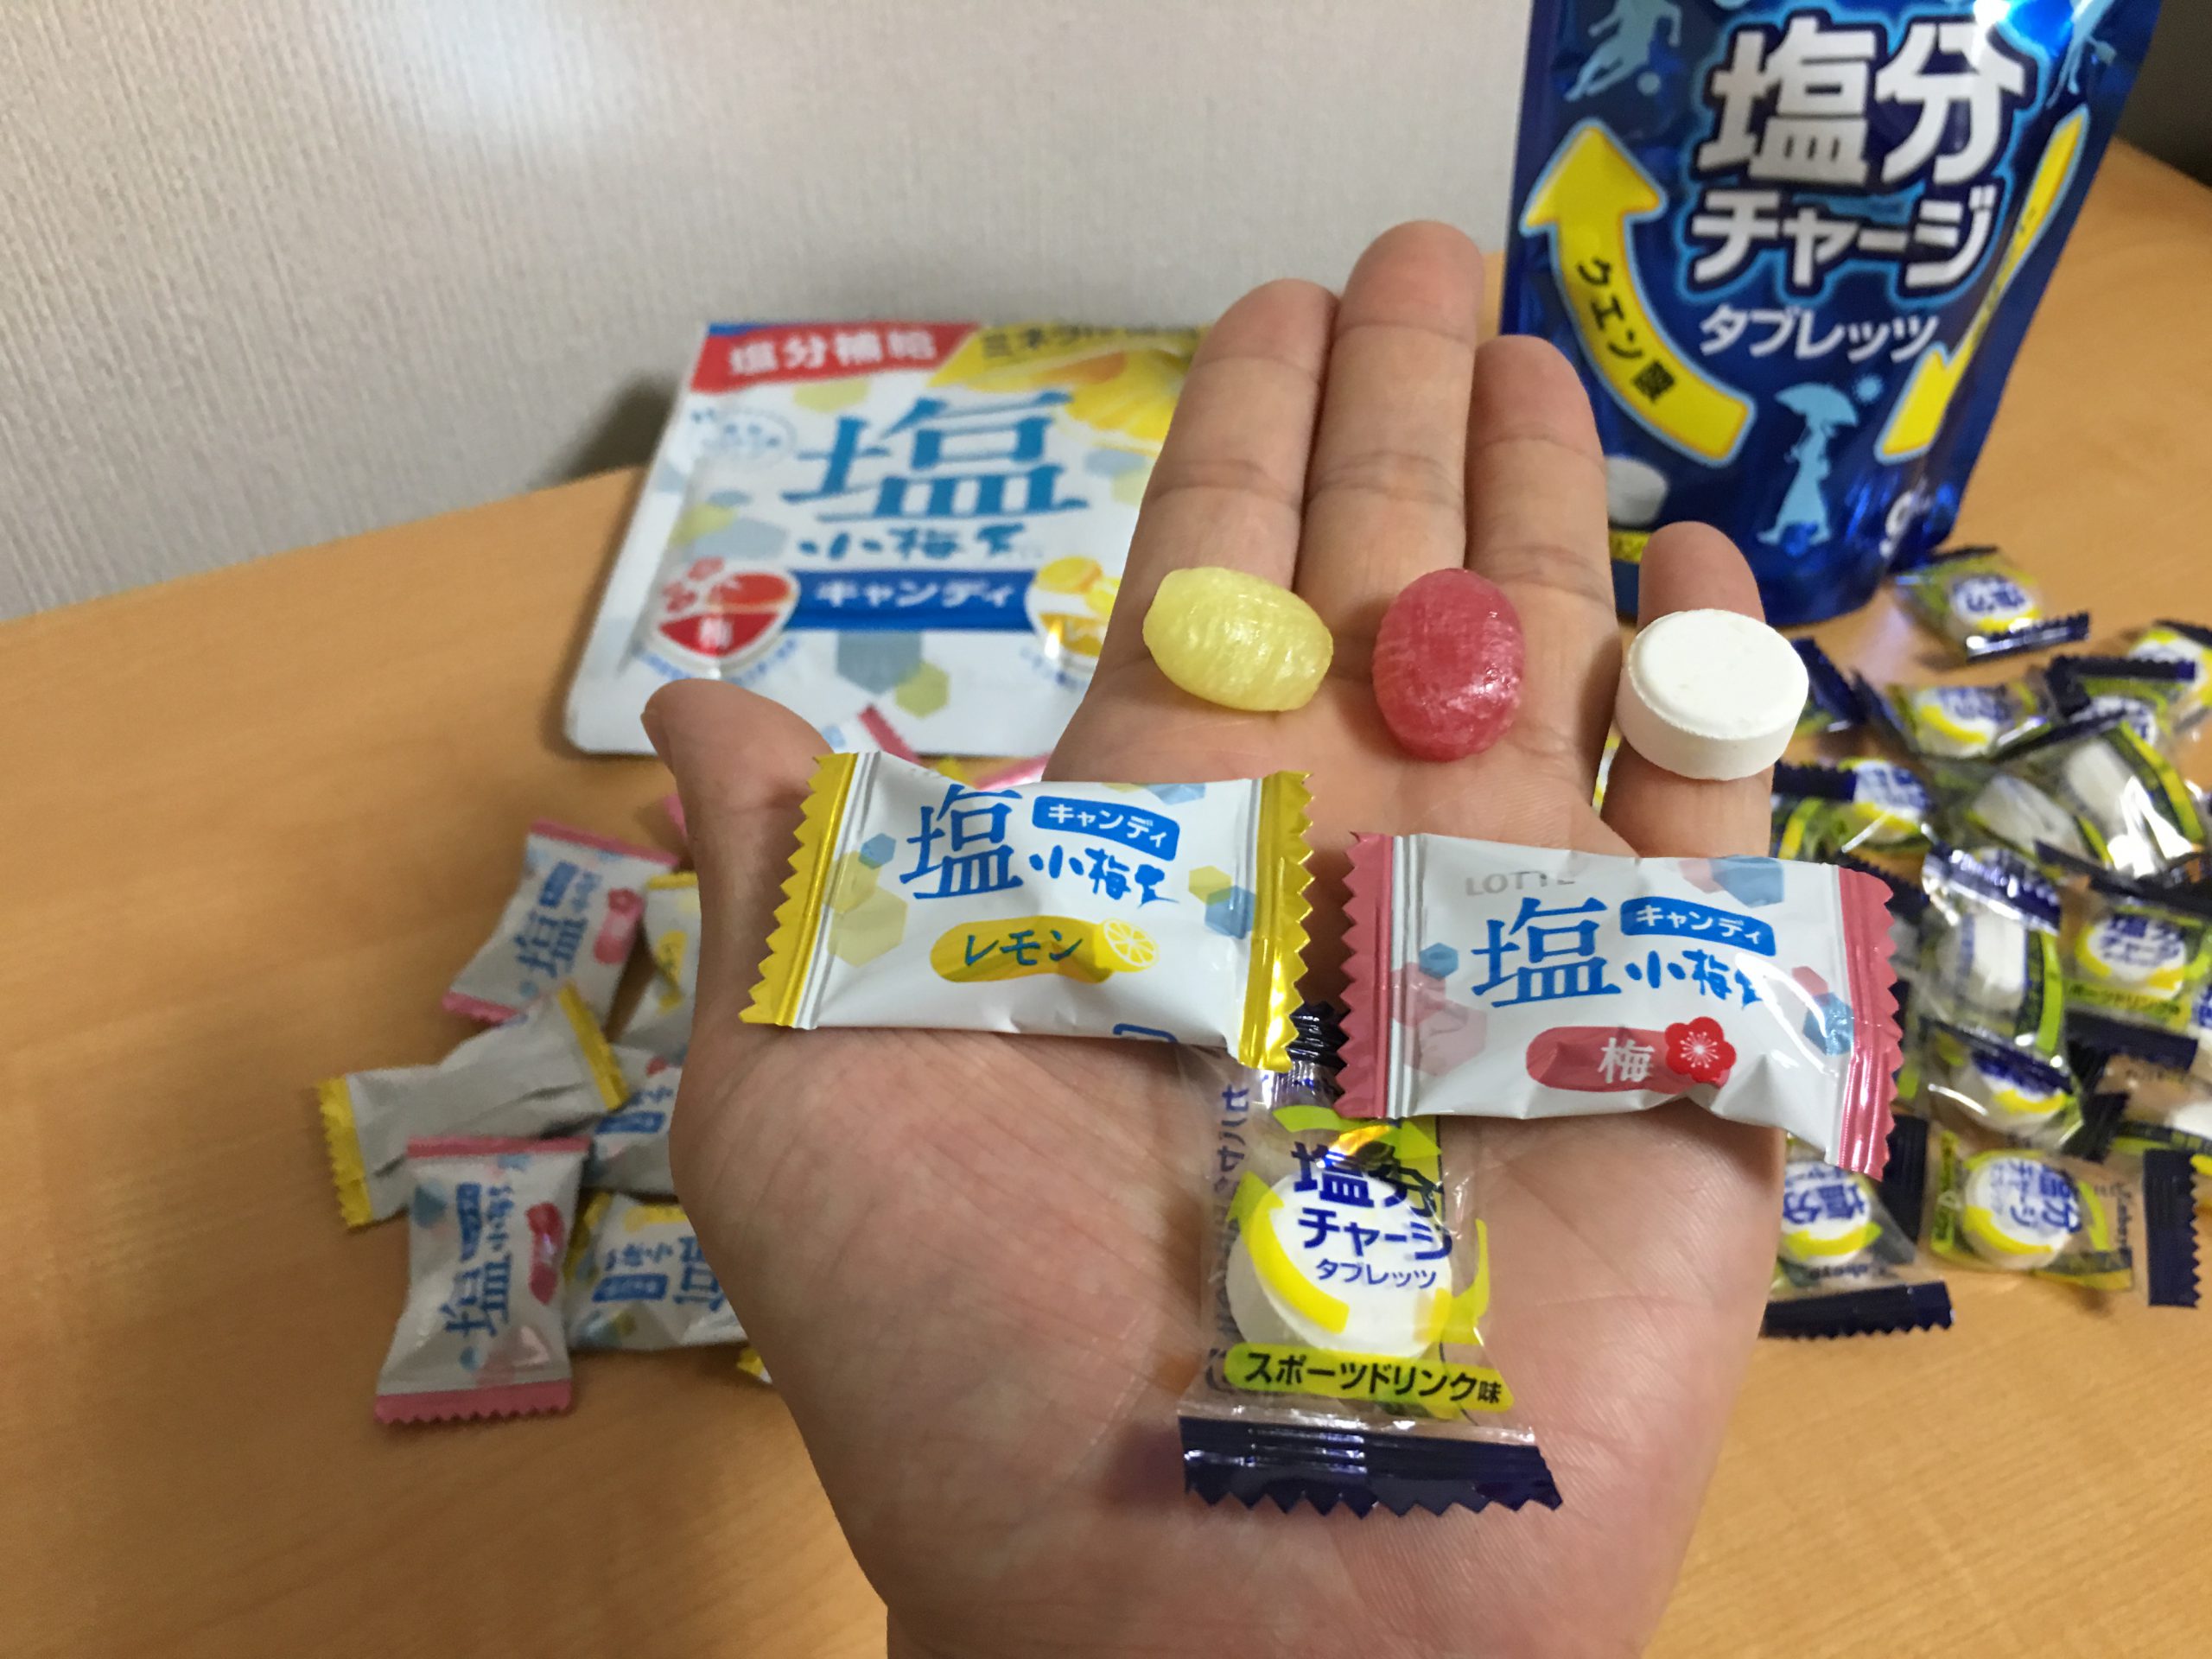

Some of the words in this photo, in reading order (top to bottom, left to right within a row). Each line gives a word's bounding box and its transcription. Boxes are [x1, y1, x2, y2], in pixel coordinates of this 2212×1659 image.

[1696, 16, 2024, 184] 塩分
[1692, 185, 1997, 289] チャージ
[1700, 303, 1939, 363] タブレッツ
[781, 393, 1089, 522] 塩
[815, 580, 1016, 607] キャンディ
[899, 783, 1023, 900] 塩
[1047, 803, 1168, 849] キャンディ
[963, 928, 1084, 968] レモン
[1635, 904, 1761, 945] キャンディ
[1470, 896, 1622, 1008] 塩
[1599, 1037, 1655, 1084] 梅
[1316, 1258, 1437, 1290] タブレッツ
[1244, 1351, 1503, 1405] スポーツドリンク味
